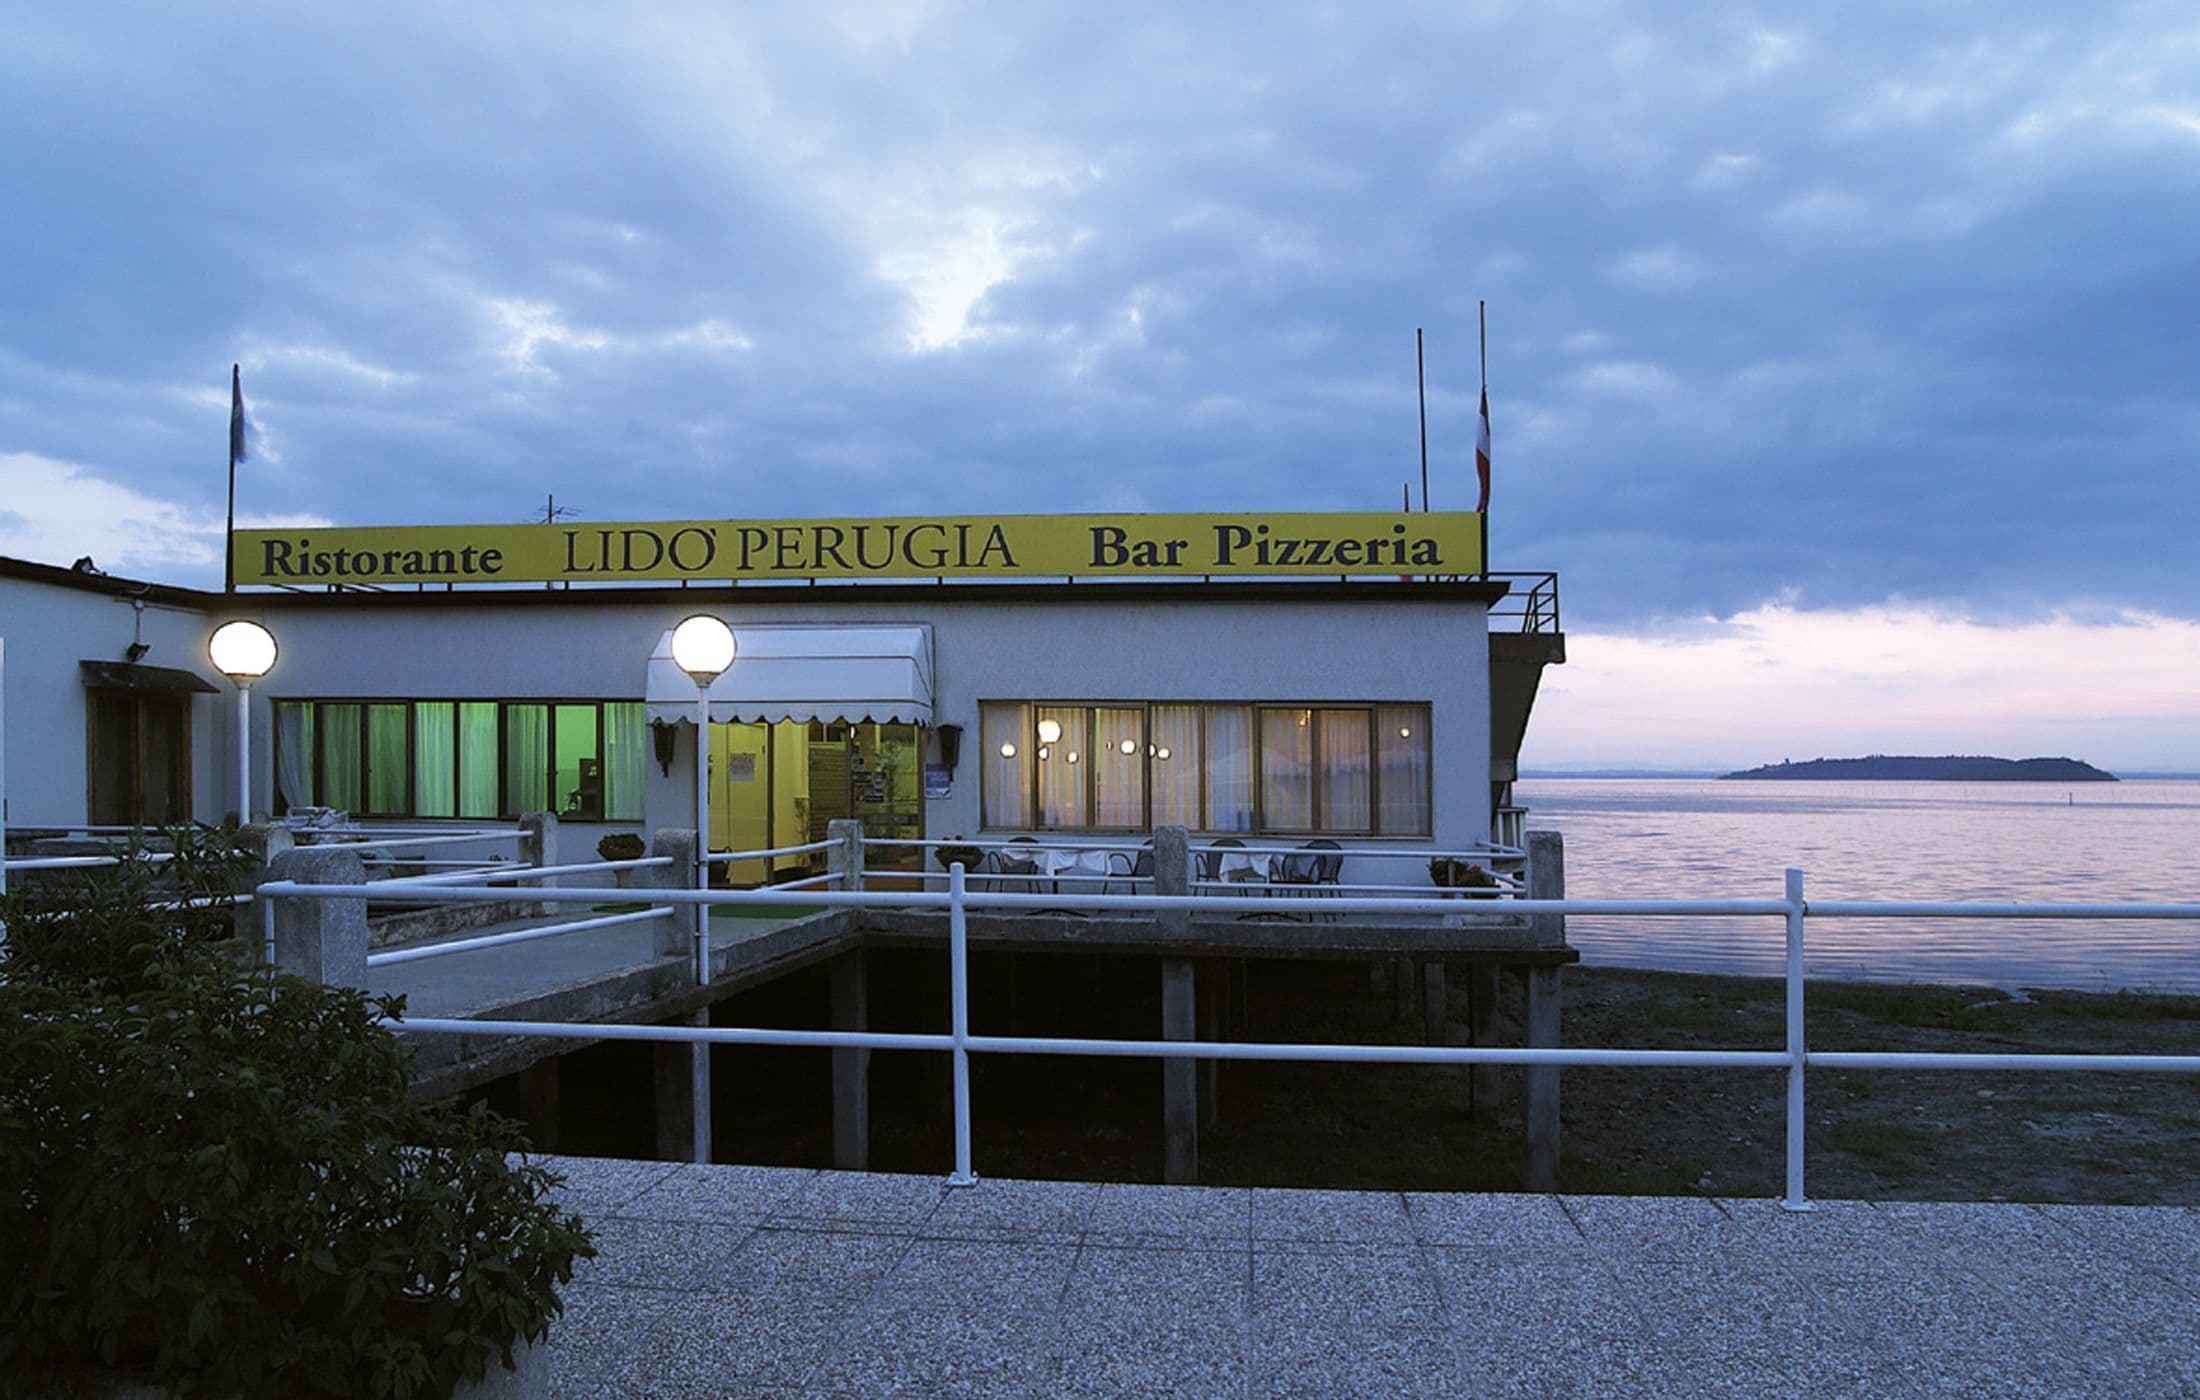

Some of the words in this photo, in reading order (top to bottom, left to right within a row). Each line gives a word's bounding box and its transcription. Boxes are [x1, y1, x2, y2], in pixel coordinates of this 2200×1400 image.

[260, 538, 503, 577] Ristorante
[736, 524, 1020, 571] PERUGIA
[1088, 525, 1189, 568] Bar
[1212, 523, 1445, 567] Pizzeria
